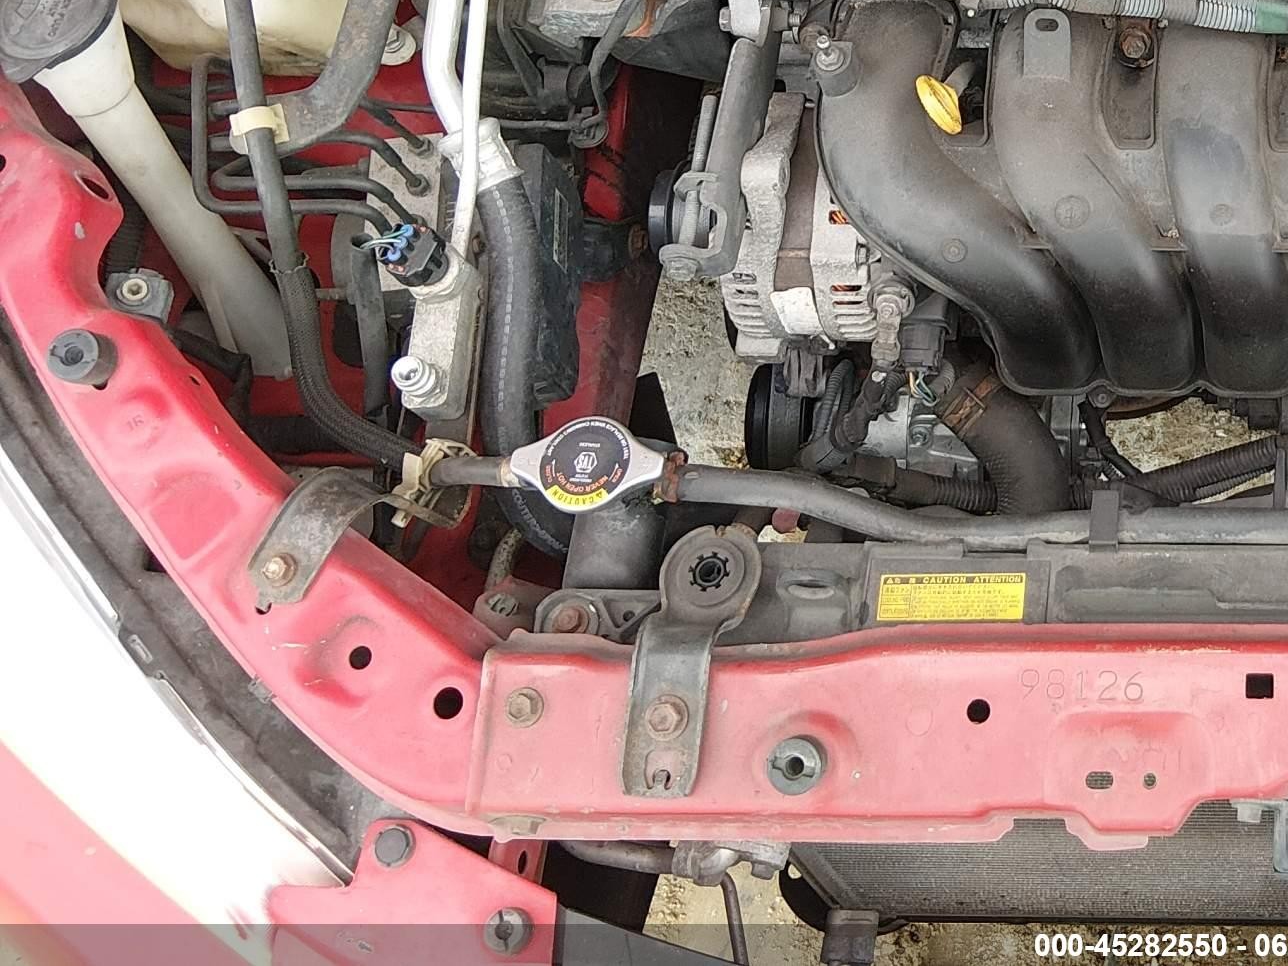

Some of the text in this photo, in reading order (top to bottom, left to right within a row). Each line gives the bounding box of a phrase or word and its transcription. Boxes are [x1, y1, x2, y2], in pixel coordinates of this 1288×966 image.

[565, 480, 584, 493] OPEN
[584, 475, 609, 492] NEVER
[552, 489, 595, 505] CAUTION
[1020, 668, 1145, 702] 98126
